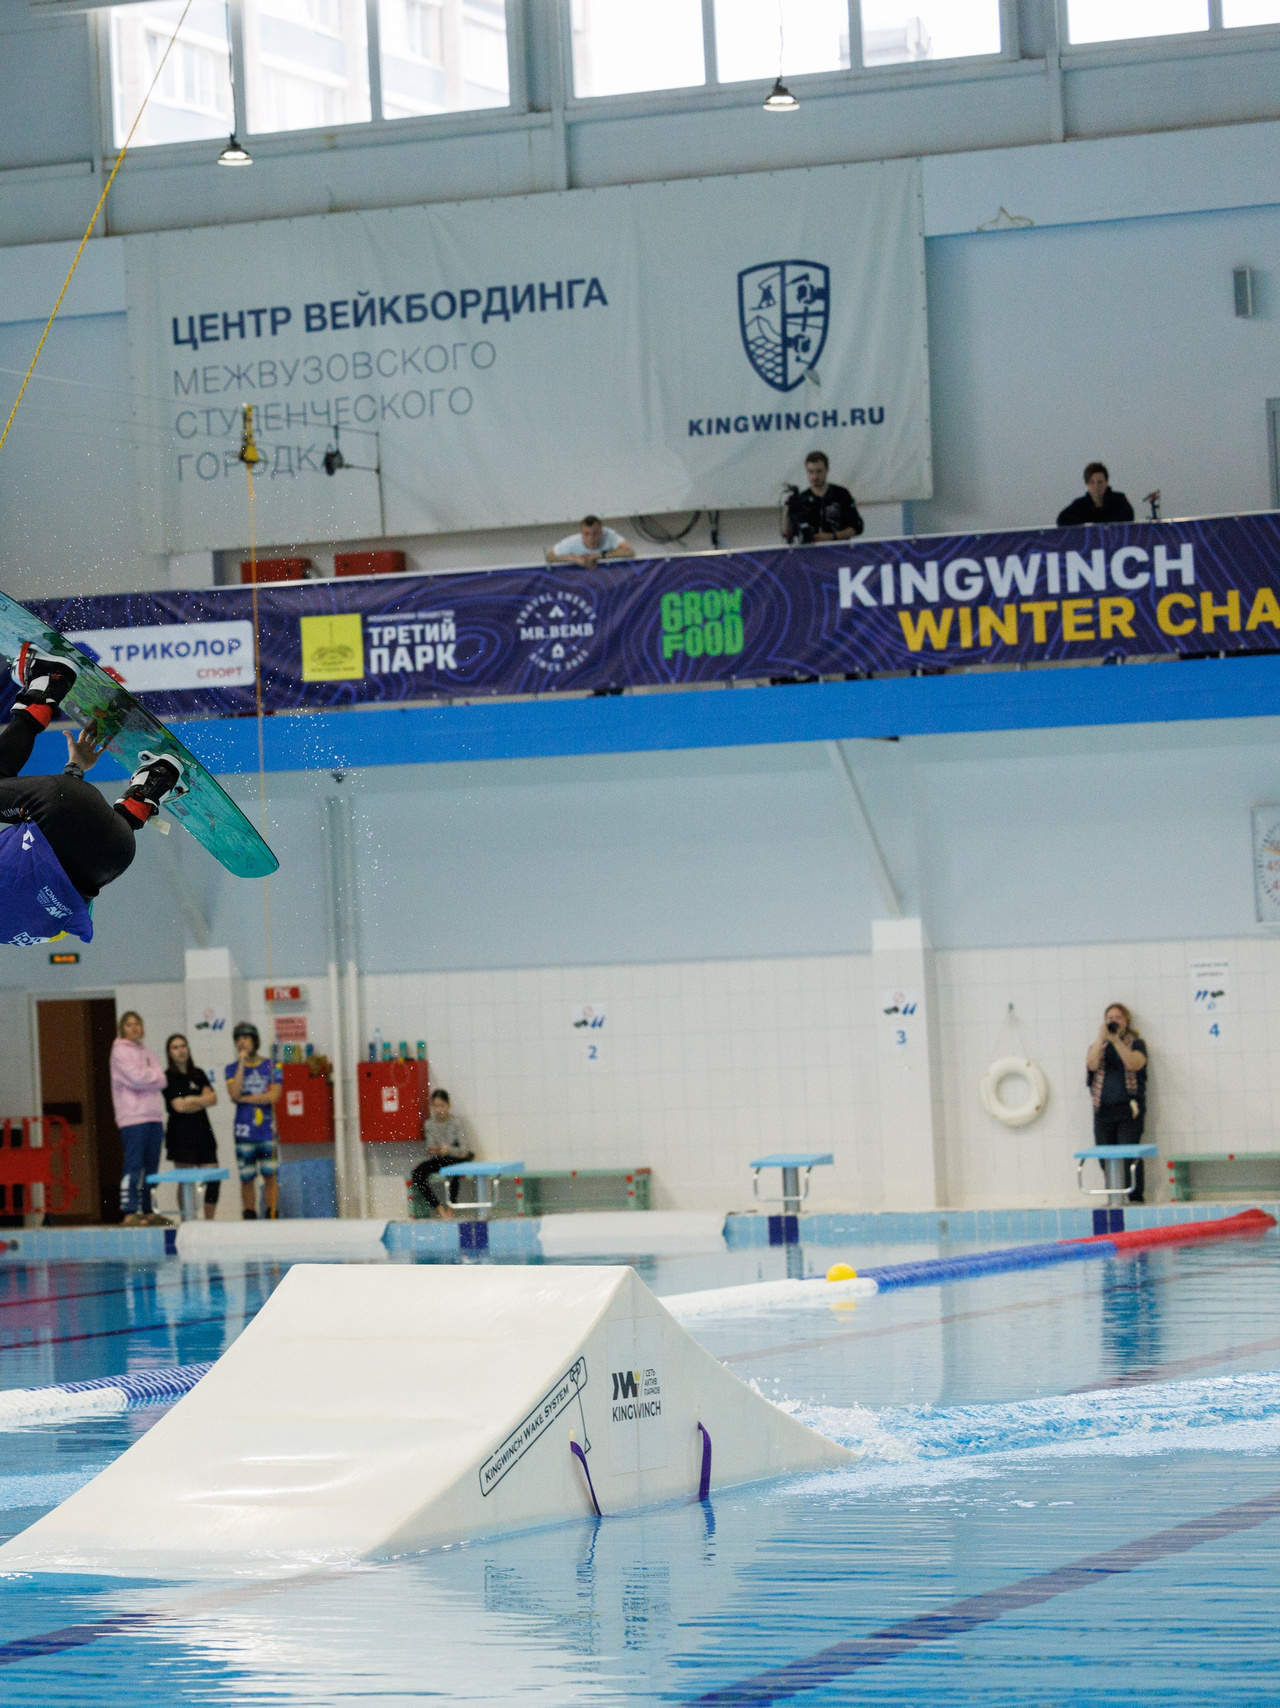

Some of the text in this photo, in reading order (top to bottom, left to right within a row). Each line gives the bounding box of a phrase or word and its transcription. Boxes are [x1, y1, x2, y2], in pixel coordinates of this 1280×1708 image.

[172, 277, 609, 350] ЦЕНТР ВЕЙКБОРДИНГА
[173, 340, 497, 396] МЕЖВУЗОВСКОГО
[688, 405, 886, 437] KINGWINCH.RU
[176, 443, 341, 482] ГОРОДК
[838, 543, 1196, 609] KINGWINCH
[661, 587, 743, 633] GROW
[898, 597, 1137, 652] WINTER
[368, 617, 457, 646] ТРЕТИЙ
[662, 613, 745, 659] FOOD
[111, 638, 242, 661] ТРИКОЛОР
[370, 643, 458, 675] ПАРК
[896, 1029, 907, 1046] 3
[1209, 1022, 1220, 1038] 4
[588, 1045, 599, 1060] 2
[612, 1400, 661, 1422] KINGWINCH
[484, 1384, 570, 1484] KINGWINCH WAKE SYSTEM
